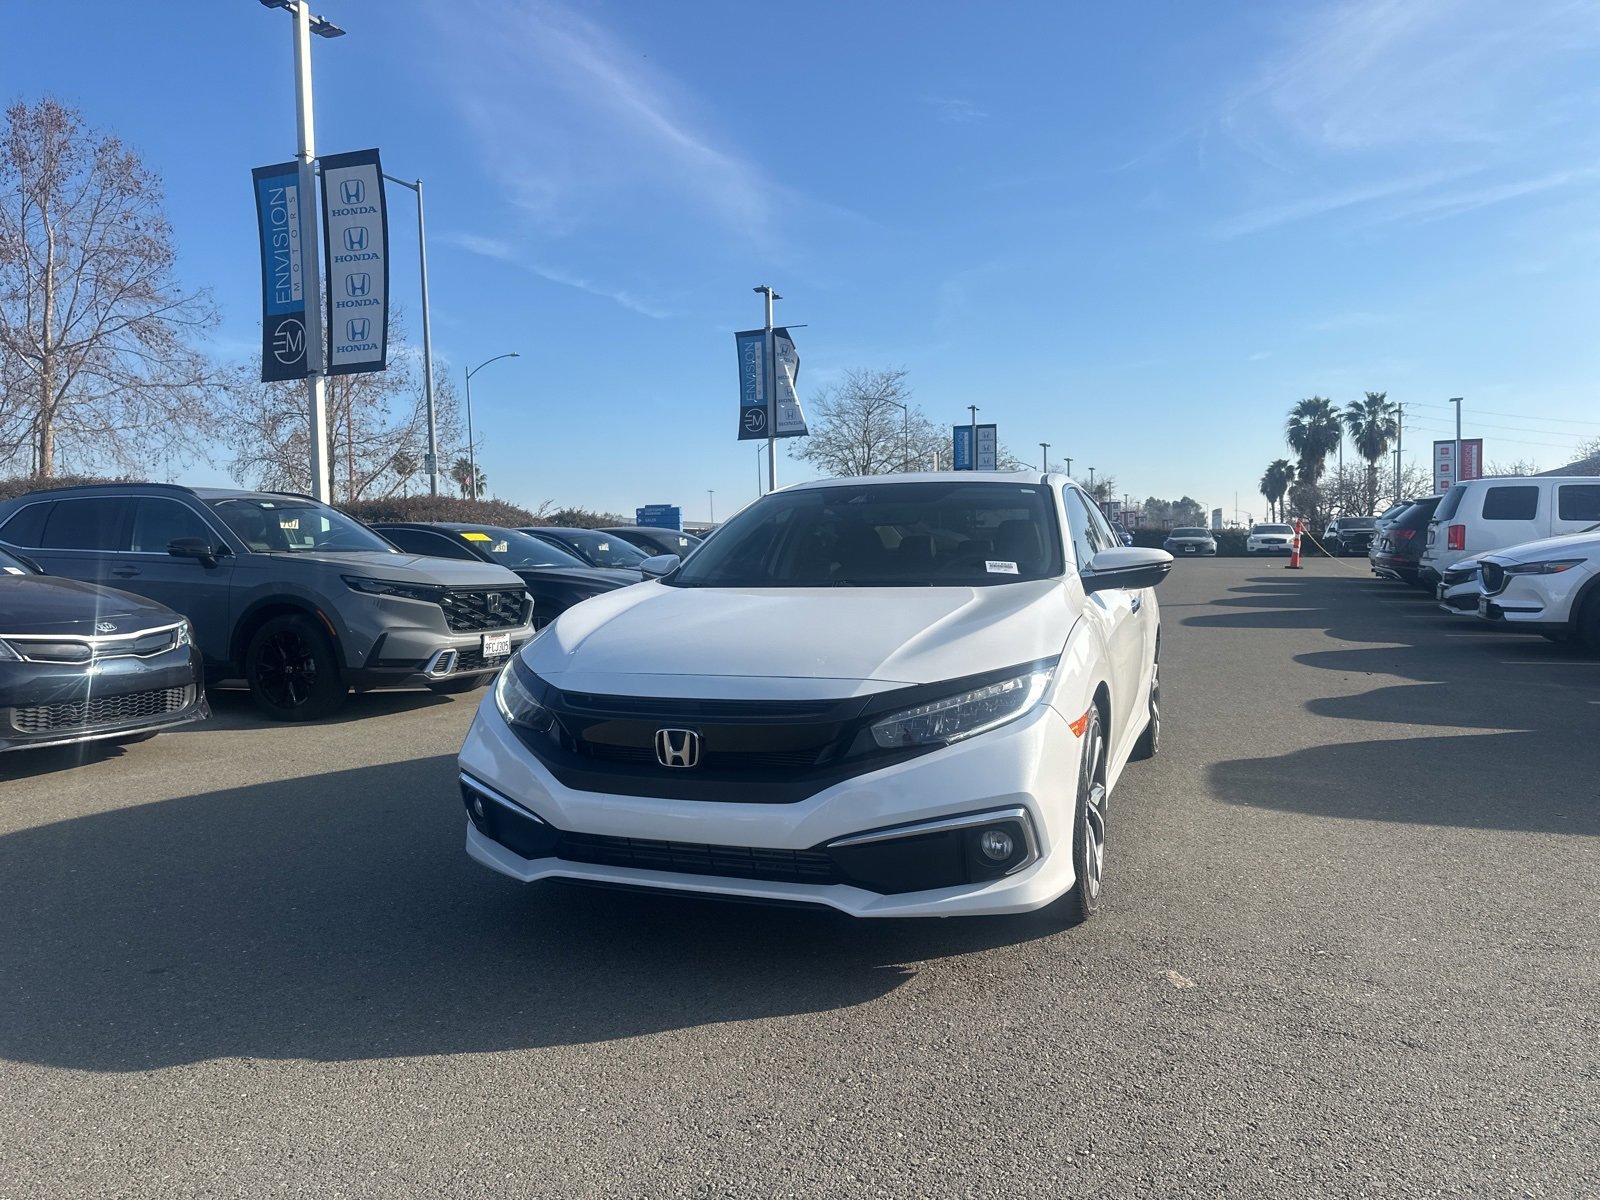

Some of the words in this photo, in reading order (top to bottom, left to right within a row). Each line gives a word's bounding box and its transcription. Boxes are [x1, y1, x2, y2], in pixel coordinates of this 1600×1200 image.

[332, 206, 377, 217] HONDA
[268, 187, 291, 304] ENVISION
[289, 196, 300, 292] MOTORS
[334, 252, 380, 263] HONDA
[336, 298, 380, 308] HONDA
[336, 342, 379, 353] HONDA
[744, 342, 756, 401] ENVISION
